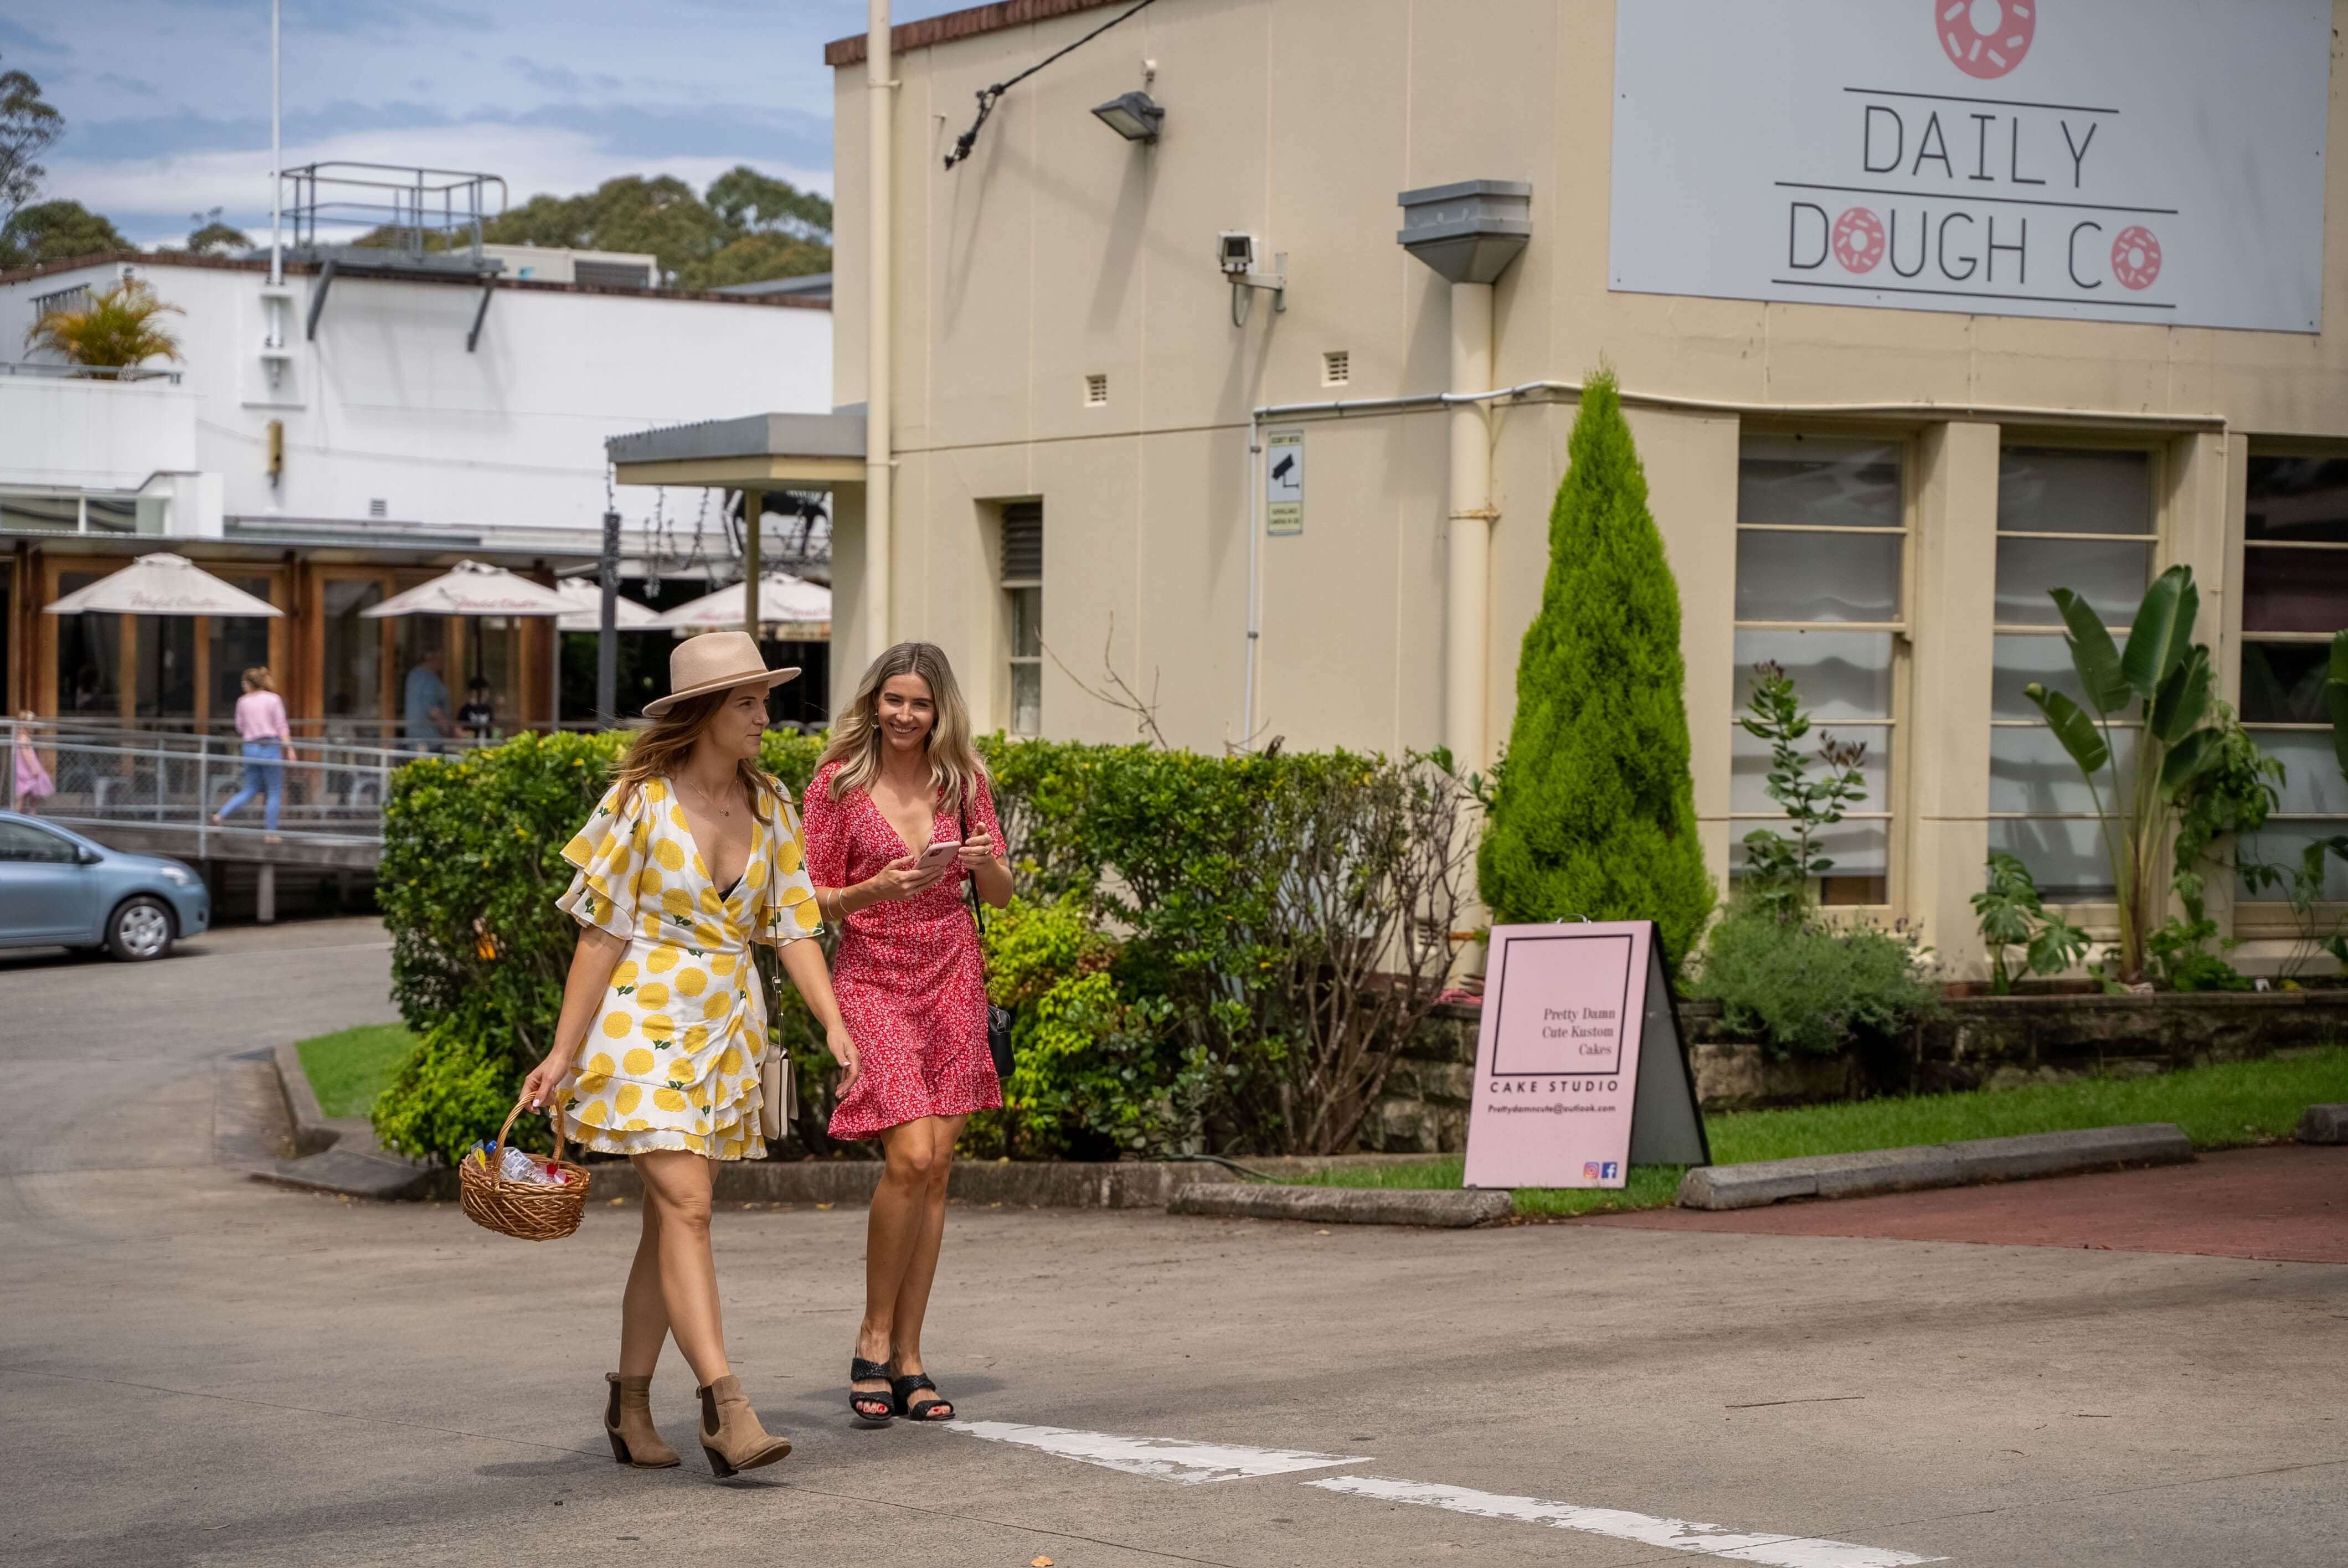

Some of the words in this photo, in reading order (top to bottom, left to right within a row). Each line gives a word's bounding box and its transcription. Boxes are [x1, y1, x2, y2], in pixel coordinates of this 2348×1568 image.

[1863, 105, 2097, 188] DAILY
[1543, 1008, 1578, 1023] Pretty
[1583, 1007, 1615, 1020] Damn
[1542, 1026, 1568, 1038] Cute
[1571, 1025, 1614, 1038] Kustom
[1579, 1043, 1612, 1055] Cakes
[1490, 1081, 1538, 1093] CAKE
[1549, 1080, 1618, 1092] STUDIO
